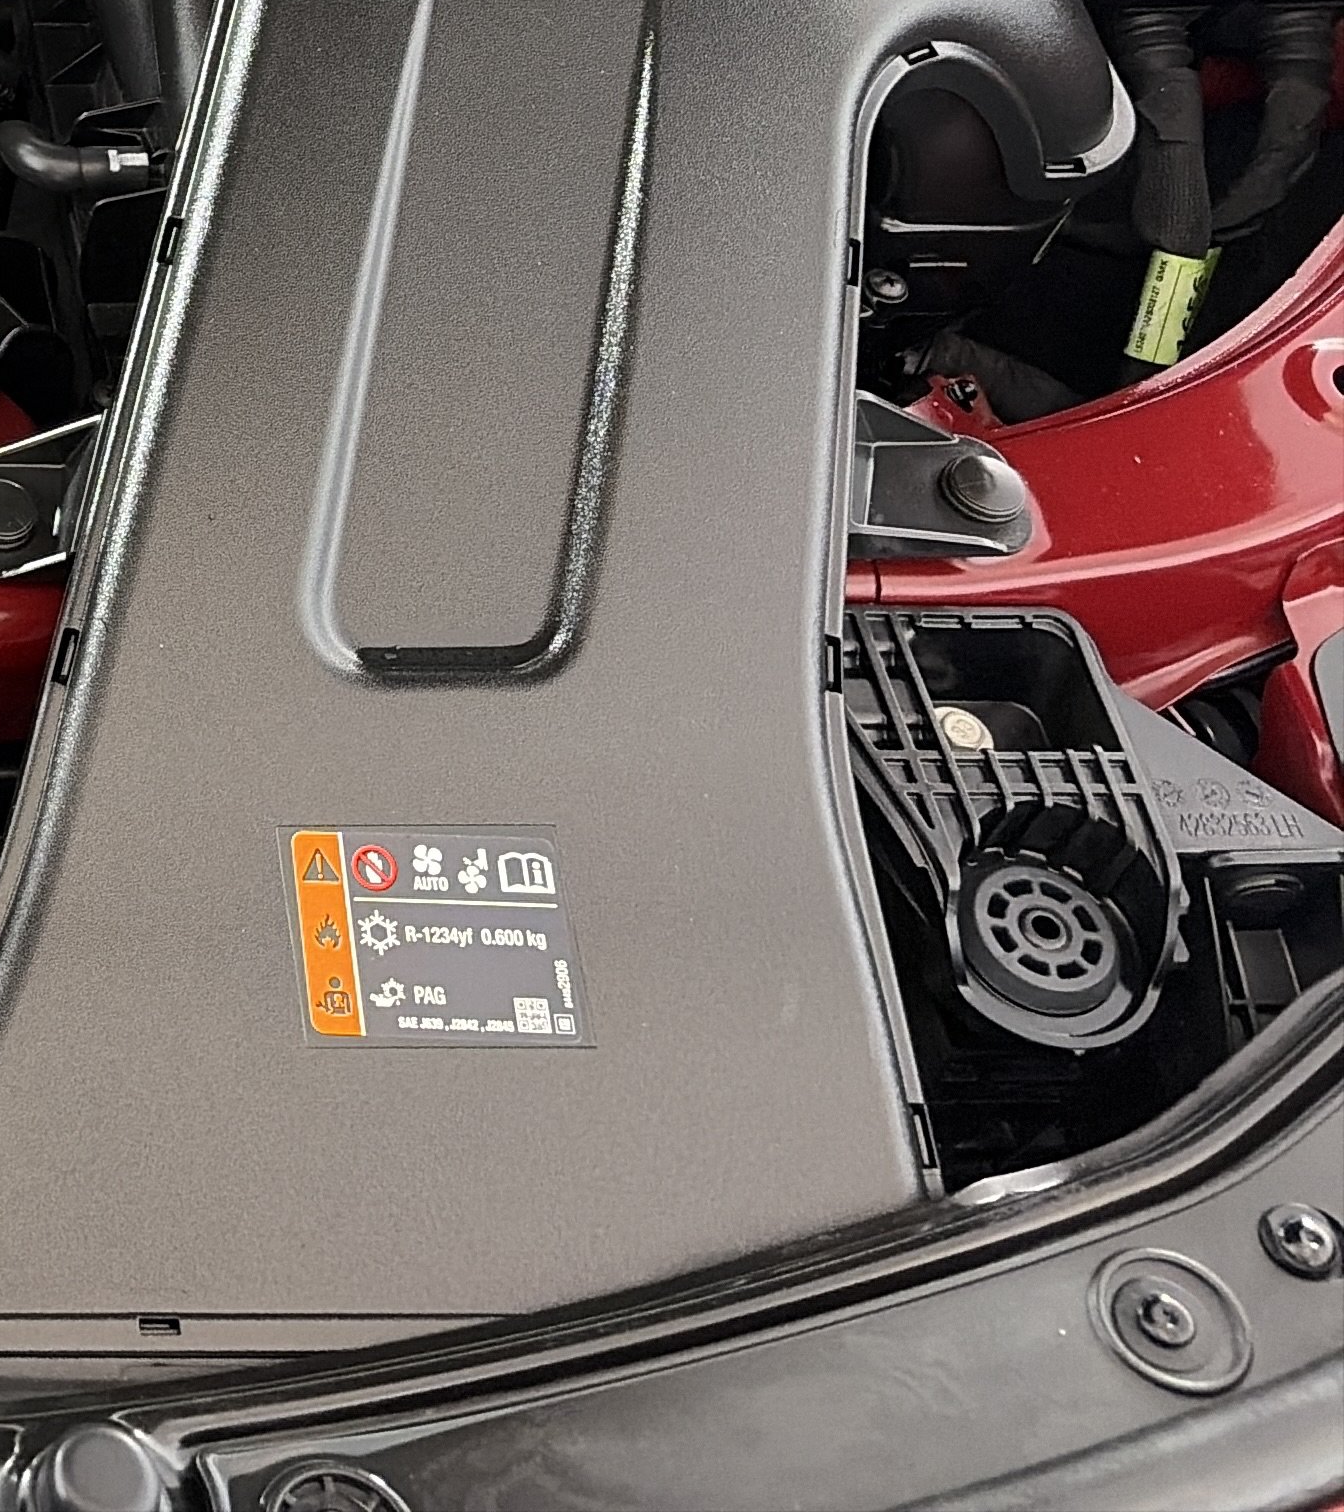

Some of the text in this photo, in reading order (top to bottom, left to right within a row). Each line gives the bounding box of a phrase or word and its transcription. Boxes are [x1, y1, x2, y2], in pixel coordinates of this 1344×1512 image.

[413, 877, 449, 892] AUTO
[404, 926, 548, 951] R-1234yf 0.600 kg
[413, 985, 447, 1006] PAG
